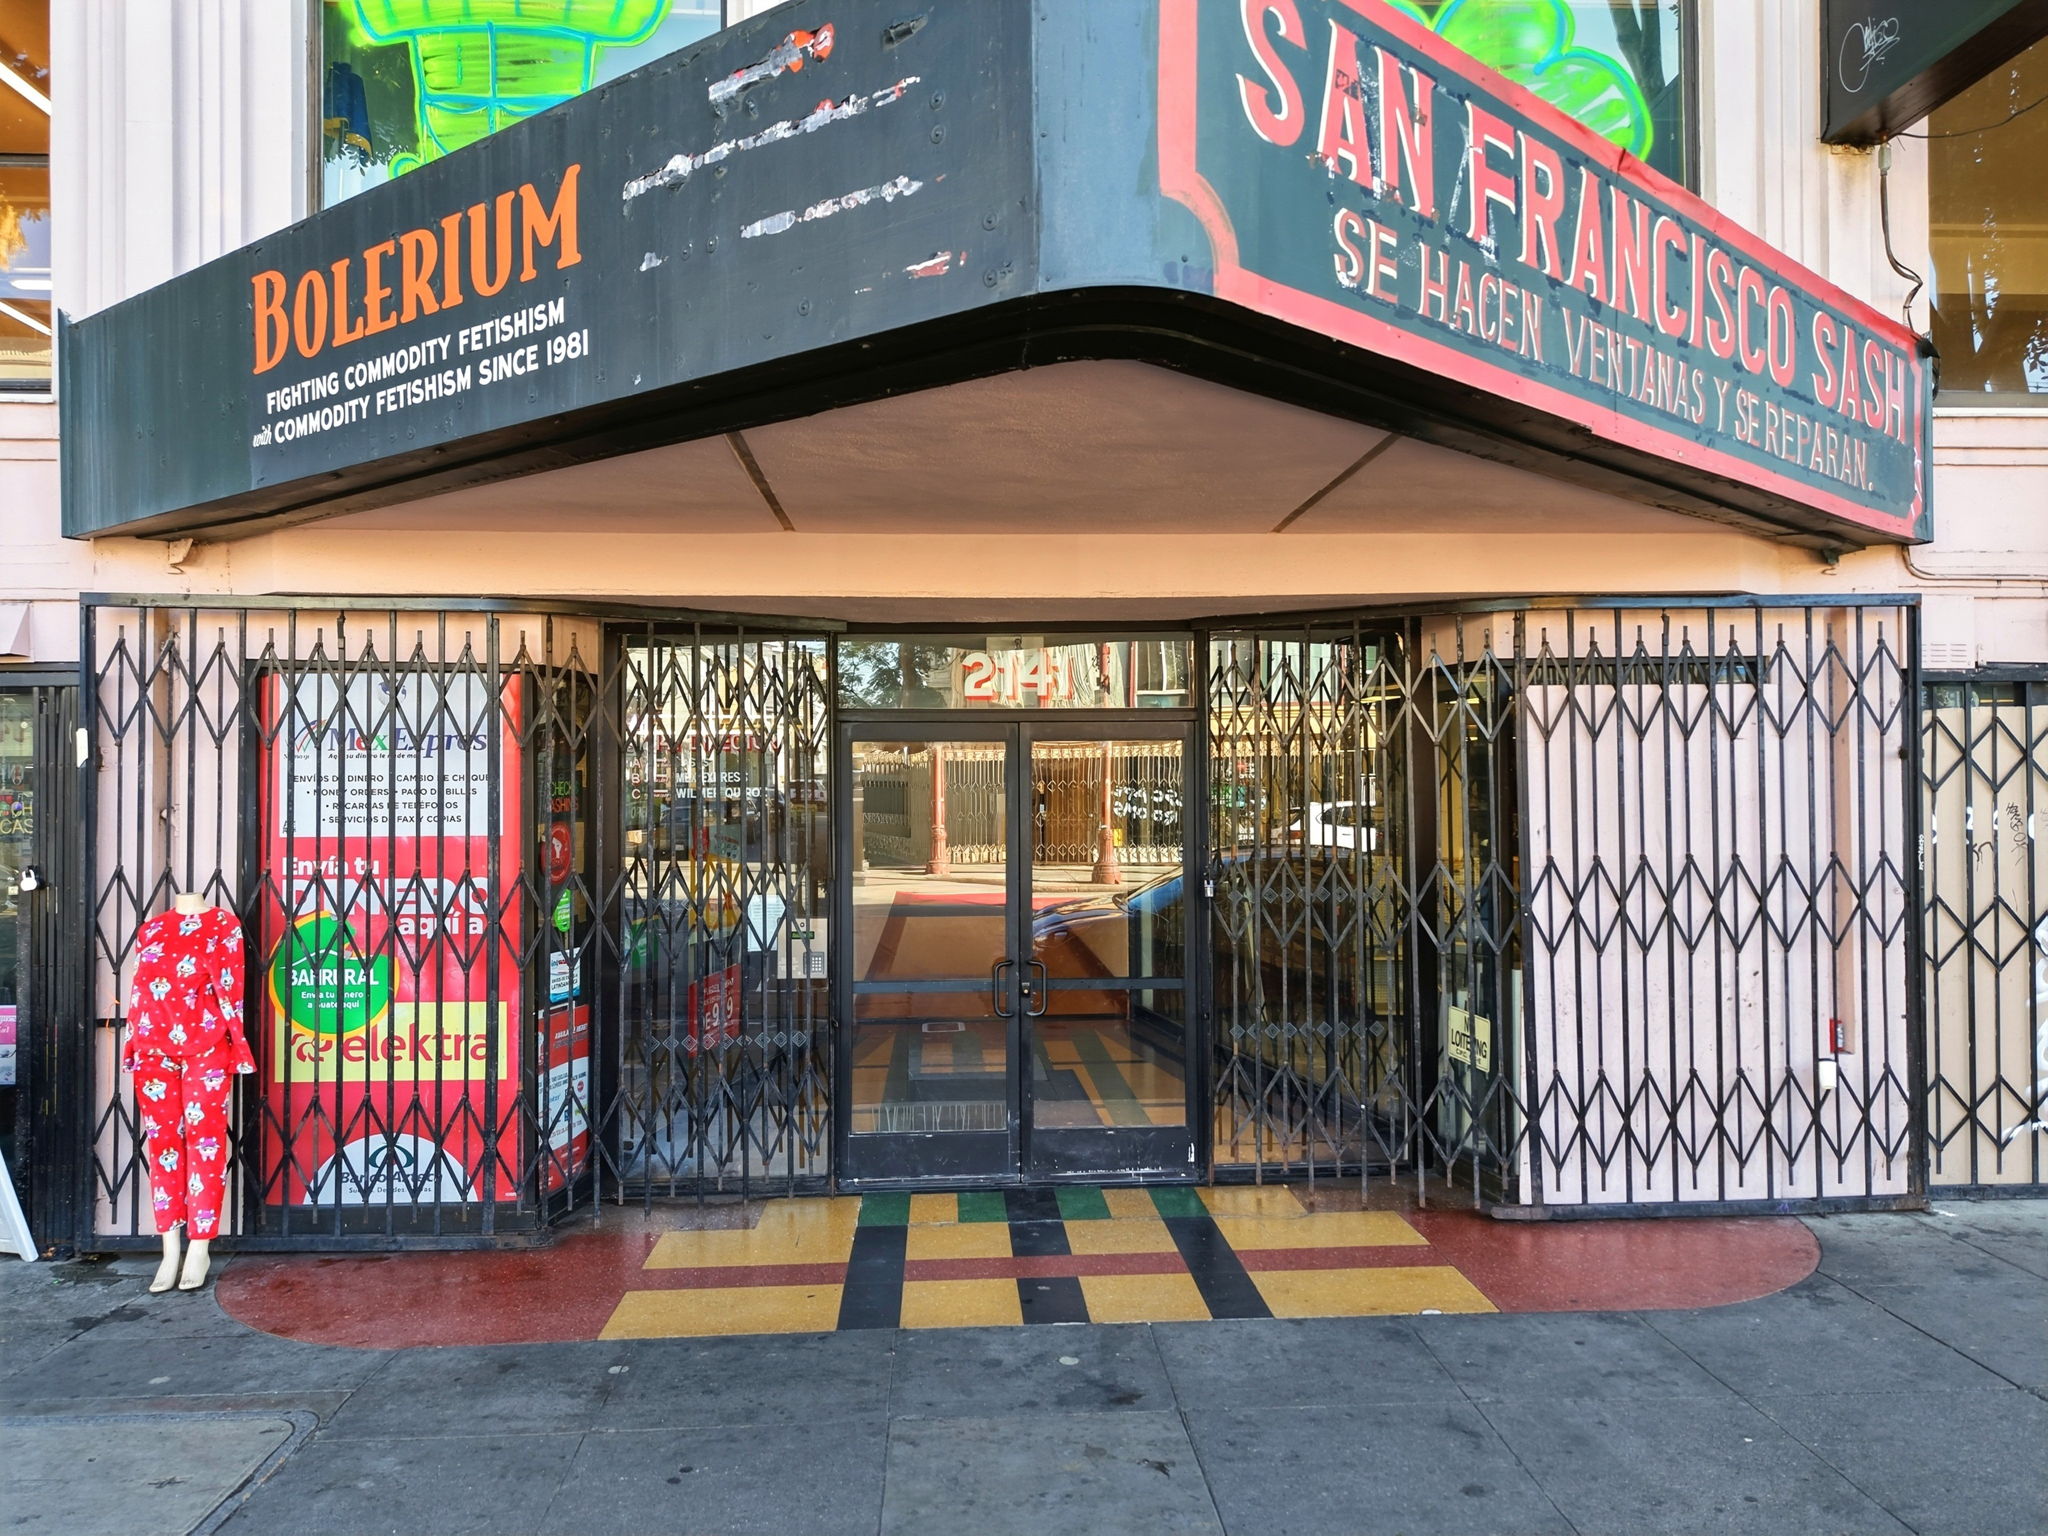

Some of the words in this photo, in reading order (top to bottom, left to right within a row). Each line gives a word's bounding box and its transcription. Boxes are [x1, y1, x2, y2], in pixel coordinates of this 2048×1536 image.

[251, 163, 582, 375] BOLERIUM
[1235, 0, 1434, 222] SAN
[1464, 100, 1795, 387] FRANCISCO
[1812, 311, 1905, 444] SASH
[266, 372, 340, 414] FIGHTING
[344, 334, 451, 388] COMMODITY
[458, 297, 565, 355] FETISHISM
[1333, 208, 1398, 304] SE
[1418, 242, 1544, 363] HACEN
[1563, 307, 1705, 424] VENTANAS
[1713, 376, 1732, 433] Y
[252, 424, 273, 447] with
[274, 395, 370, 443] COMMODITY
[376, 365, 471, 415] FETISHISM
[478, 345, 539, 386] SINCE
[546, 329, 589, 366] 1981
[962, 652, 1072, 701] 2141
[354, 856, 379, 875] tu
